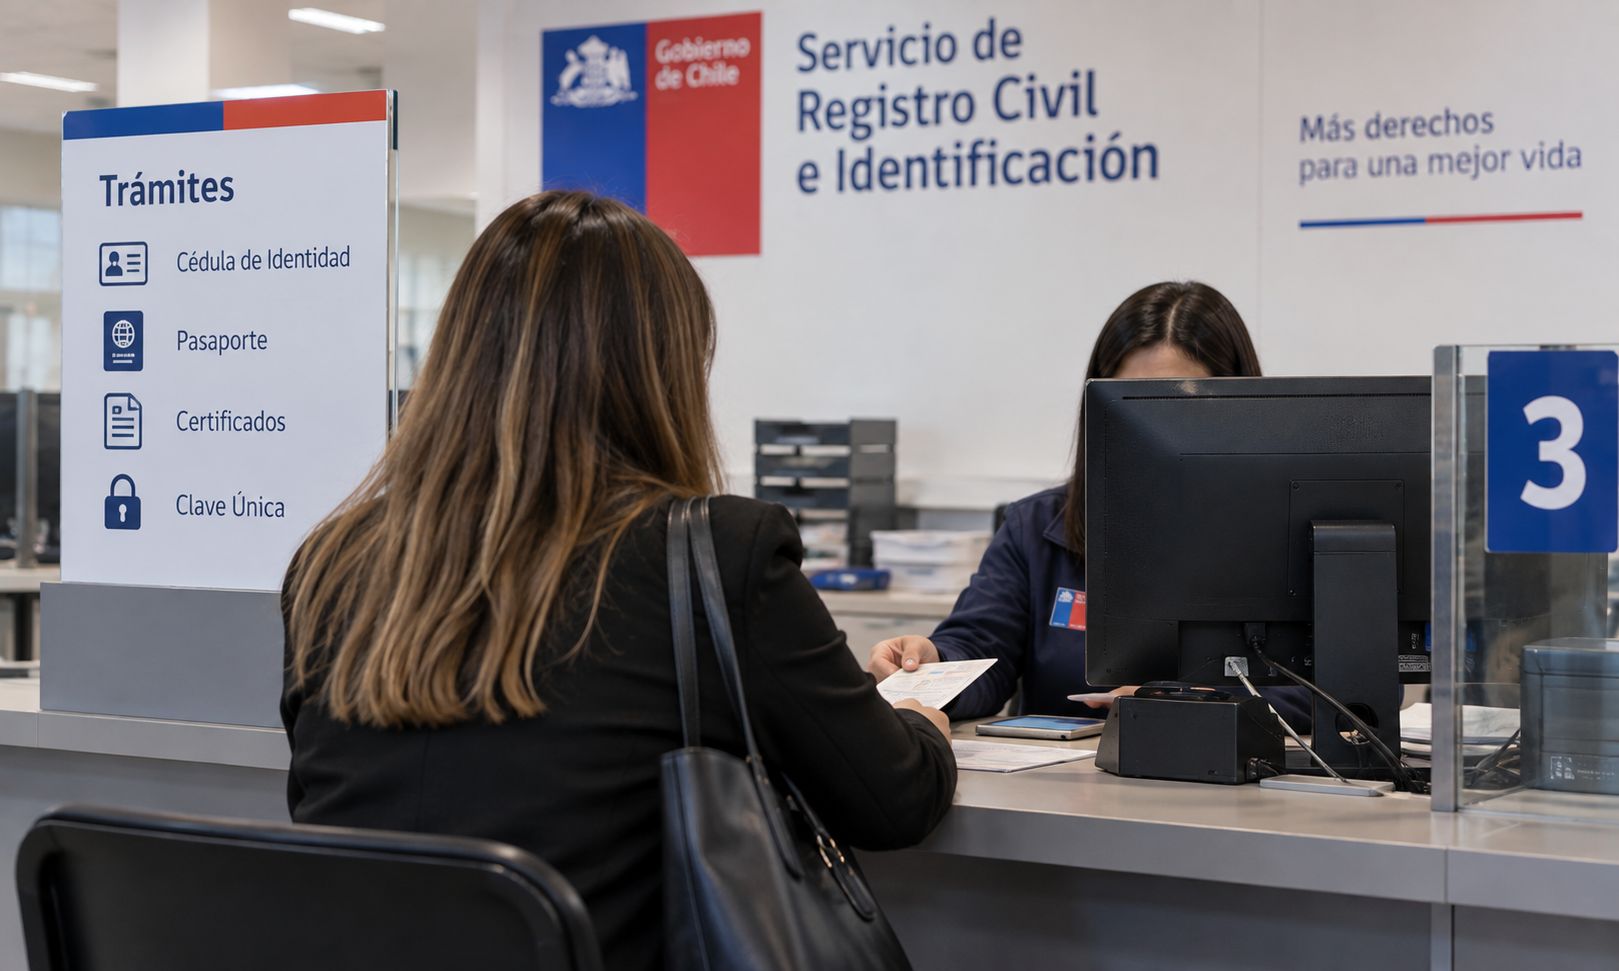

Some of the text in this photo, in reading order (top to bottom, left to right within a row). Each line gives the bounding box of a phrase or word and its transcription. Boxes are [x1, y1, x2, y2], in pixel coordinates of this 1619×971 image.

[655, 36, 751, 64] Gobierno
[797, 18, 1023, 73] Servicio de
[655, 61, 740, 91] de Chile
[798, 70, 1098, 142] Registro Civil
[1300, 107, 1494, 142] Más derechos
[797, 132, 1159, 195] e Identificación
[1299, 140, 1582, 187] para una mejor vida
[99, 169, 235, 207] Trámites
[176, 245, 350, 272] Cédula de Identidad
[177, 329, 268, 356] Pasaporte
[176, 409, 286, 432] Certificados
[1520, 395, 1587, 510] 3
[176, 490, 285, 518] Clave Única
